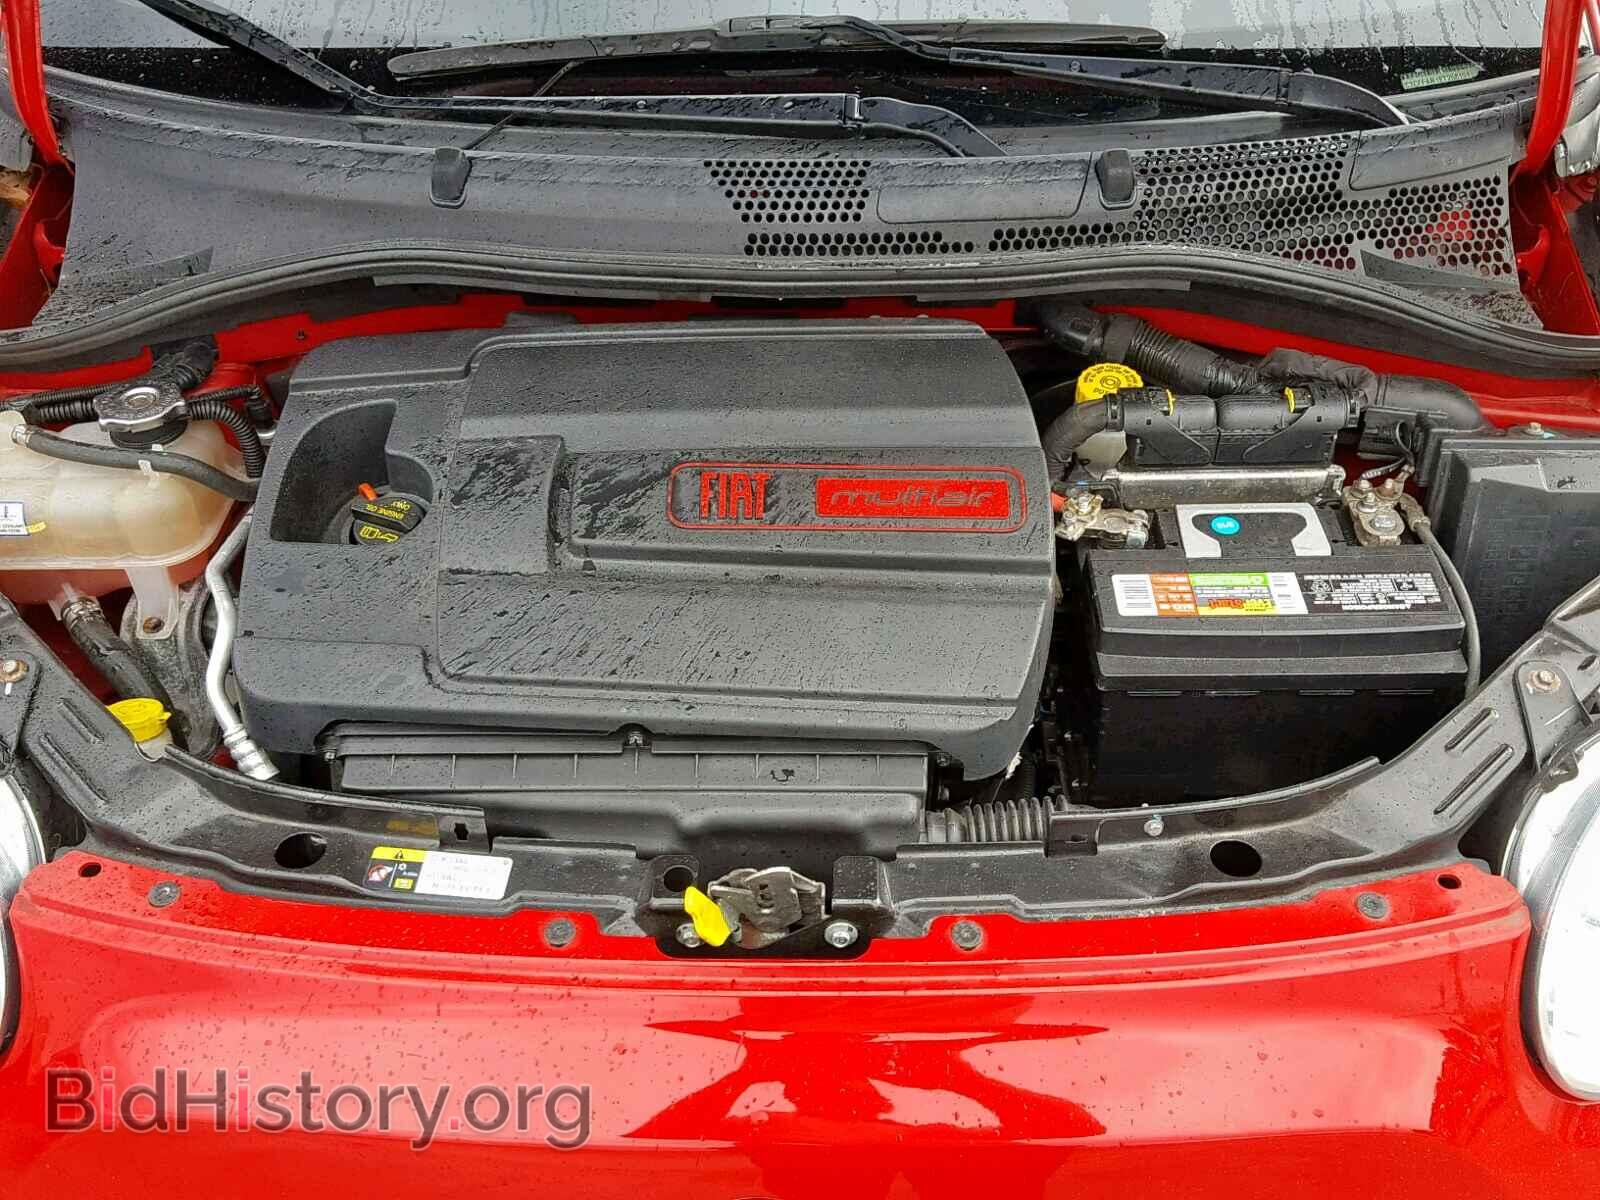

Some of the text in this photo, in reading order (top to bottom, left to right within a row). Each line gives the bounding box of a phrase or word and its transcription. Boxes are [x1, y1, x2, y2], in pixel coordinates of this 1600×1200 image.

[699, 472, 993, 521] FIAT multiair
[391, 501, 410, 511] ONLY
[377, 508, 404, 519] ENGINE
